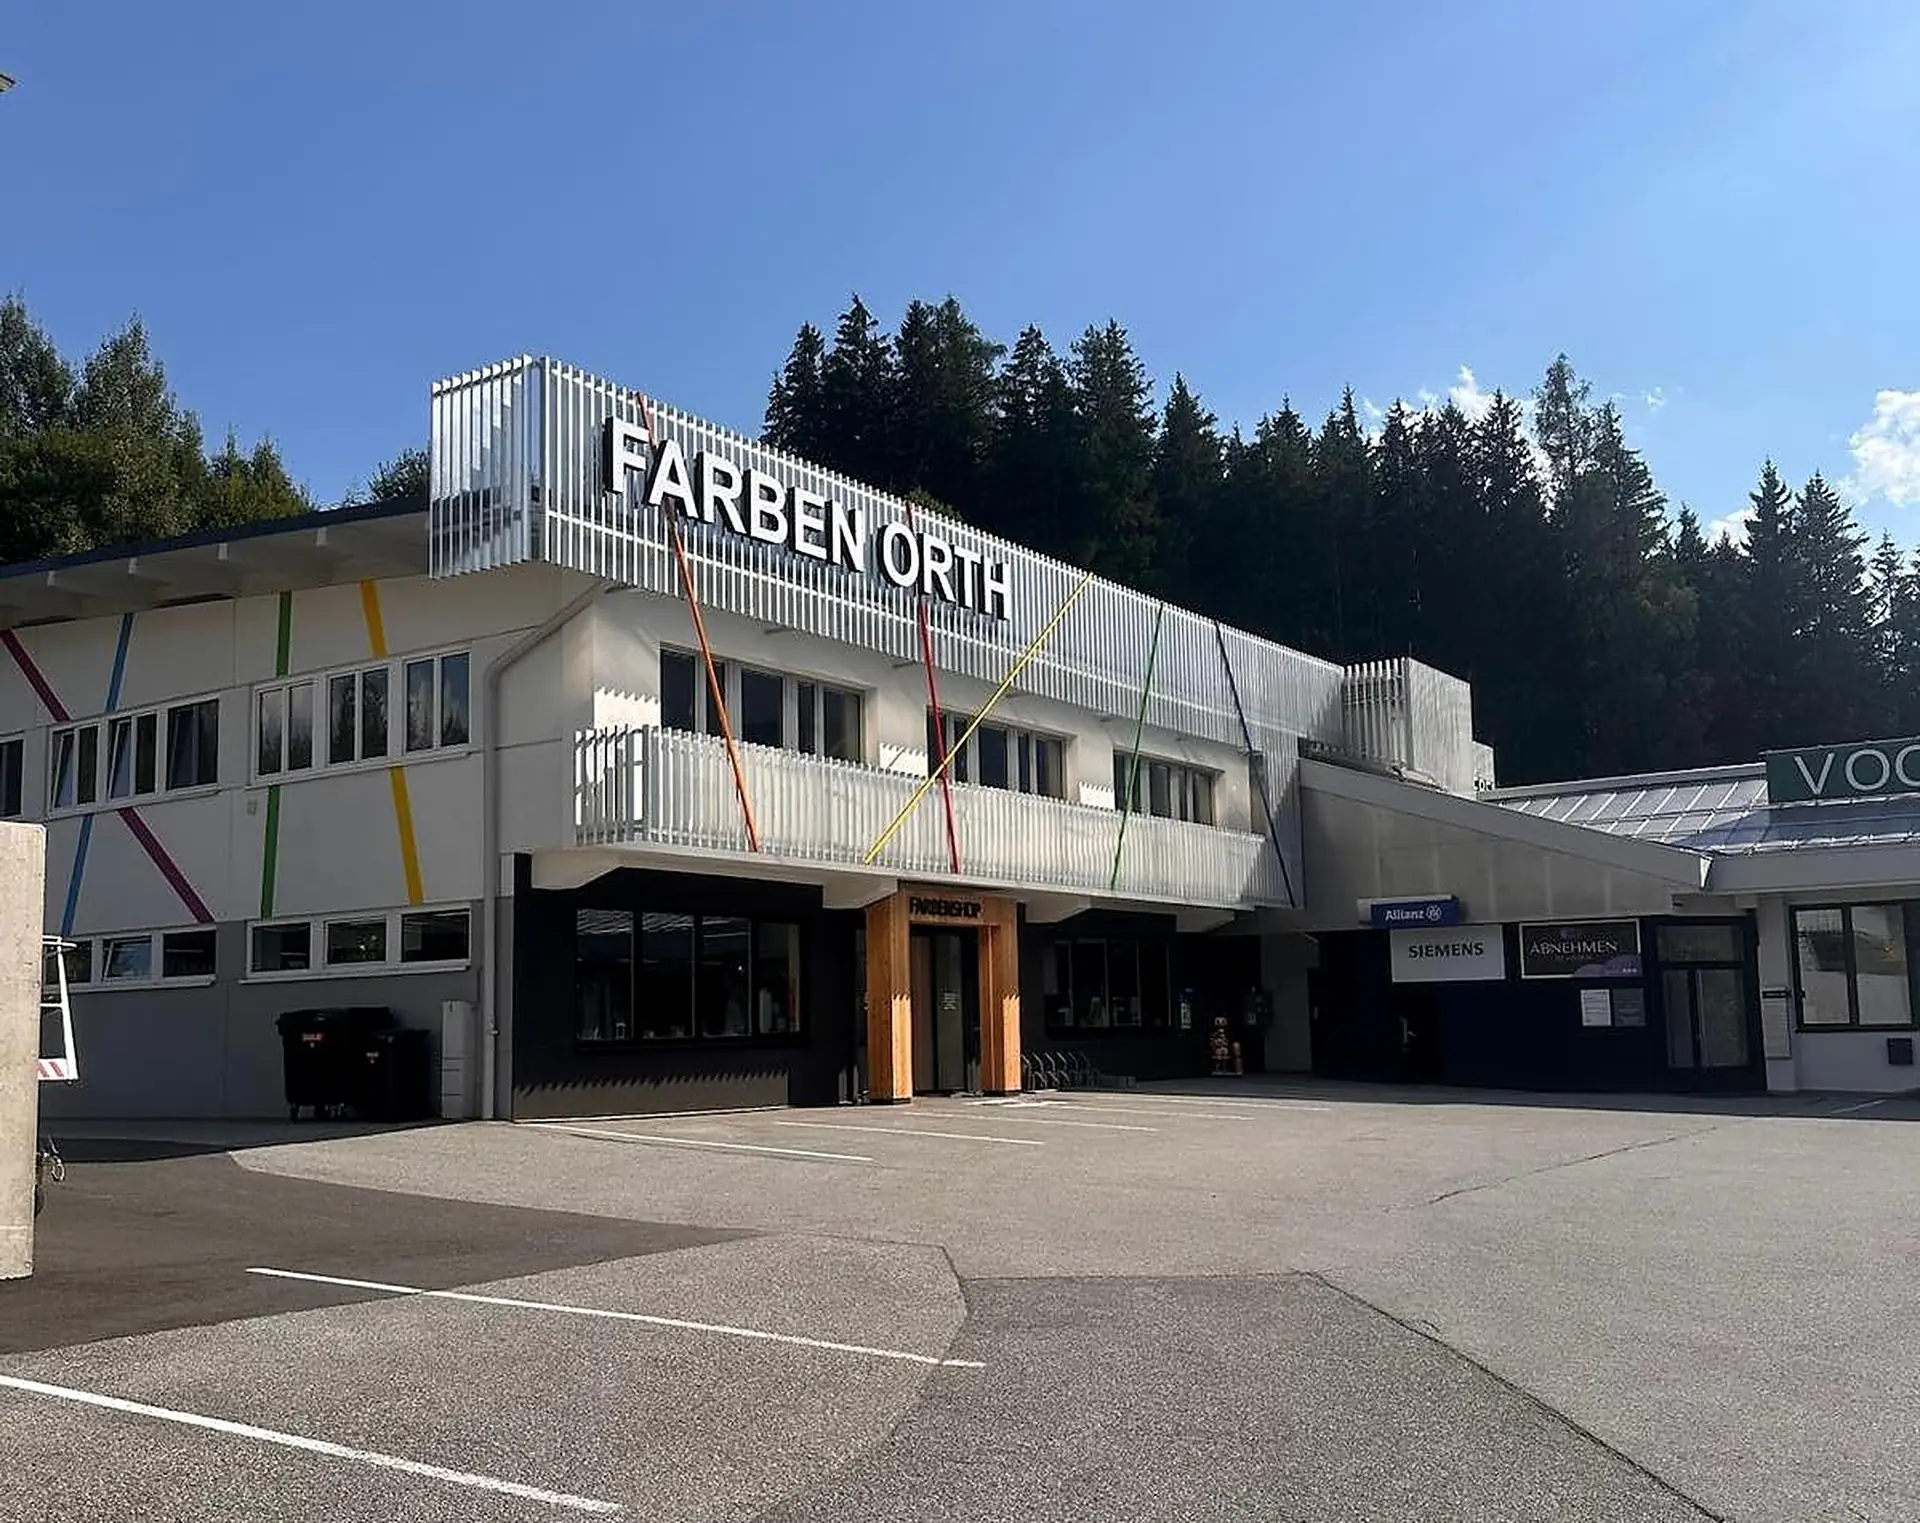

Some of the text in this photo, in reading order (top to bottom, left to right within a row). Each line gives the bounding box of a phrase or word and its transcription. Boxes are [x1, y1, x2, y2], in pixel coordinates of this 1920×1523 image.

[606, 418, 1011, 620] FARBEN ORTH
[1385, 908, 1425, 921] Allianz
[1408, 942, 1484, 959] SIEMENS
[1530, 940, 1618, 955] ABNEHMEN
